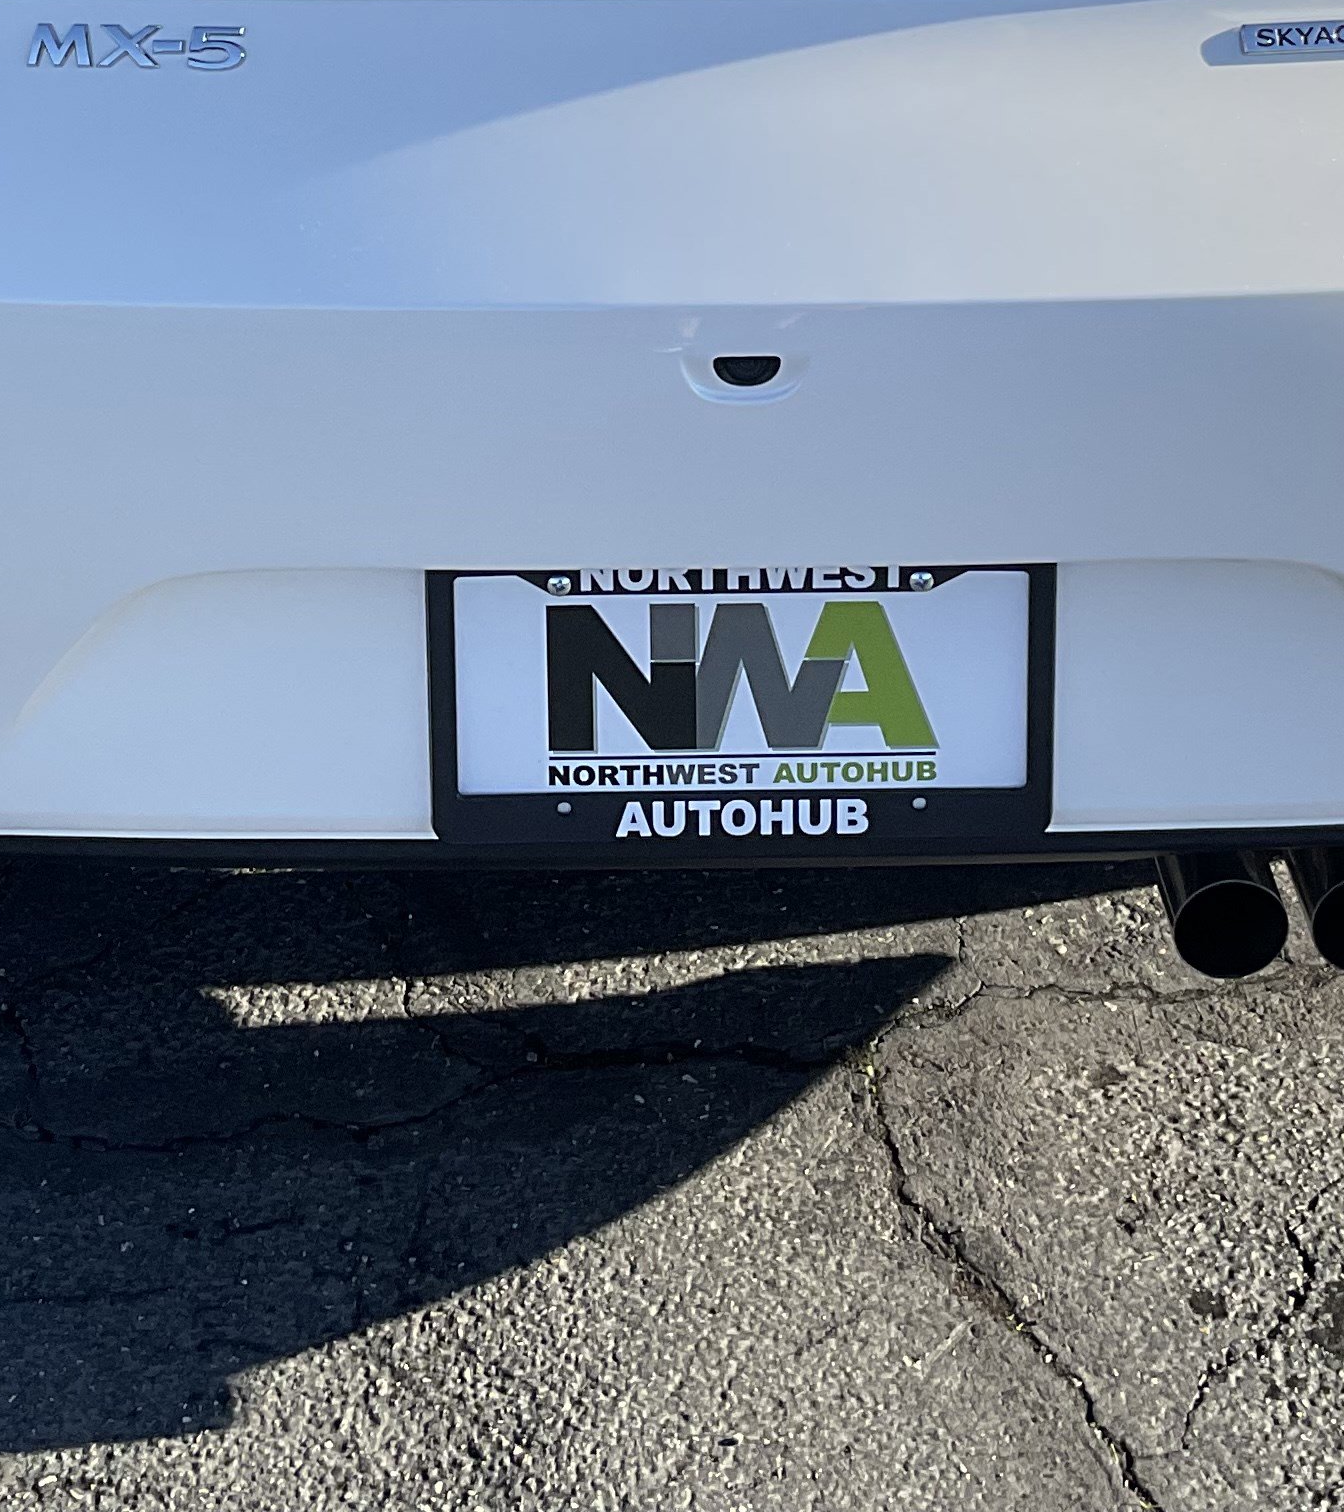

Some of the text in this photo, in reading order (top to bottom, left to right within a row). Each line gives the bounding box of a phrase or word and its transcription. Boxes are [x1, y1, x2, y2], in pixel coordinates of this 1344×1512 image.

[26, 23, 246, 70] MX-5
[579, 568, 901, 592] NORTHWEST
[549, 761, 937, 787] NORTHWEST AUTOHUB
[616, 798, 869, 838] AUTOHUB
